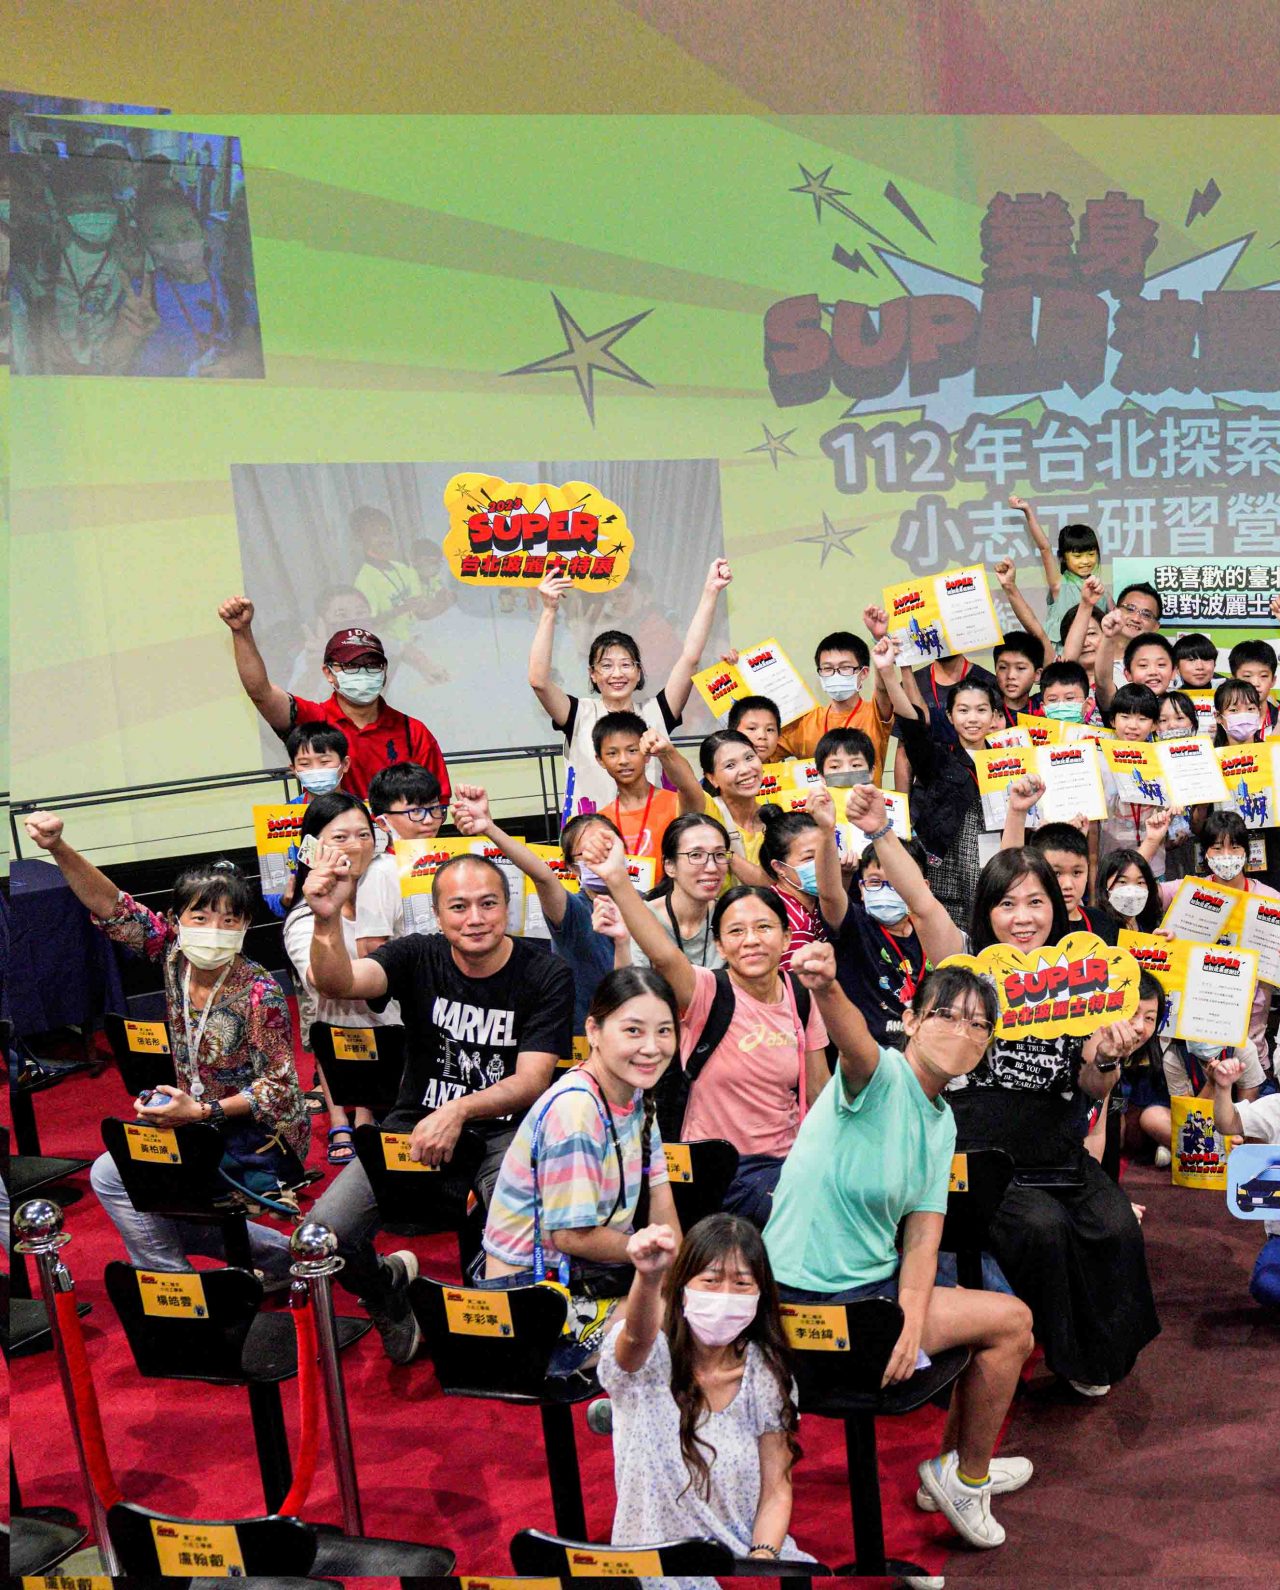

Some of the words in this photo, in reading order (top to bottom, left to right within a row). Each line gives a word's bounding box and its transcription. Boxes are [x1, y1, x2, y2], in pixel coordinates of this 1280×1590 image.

[980, 192, 1157, 291] 變身
[764, 290, 1109, 406] SUPER
[487, 498, 523, 513] 2023
[468, 511, 599, 554] SUPER
[461, 556, 617, 579] 台北波麗士特展
[1203, 954, 1241, 970] SUPER
[1004, 957, 1109, 1009] SUPER
[432, 996, 517, 1046] MARVEL
[1002, 991, 1125, 1028] 台北波麗士特展
[1014, 1061, 1025, 1069] BE
[1026, 1064, 1041, 1074] YOU
[535, 1247, 543, 1276] MINION
